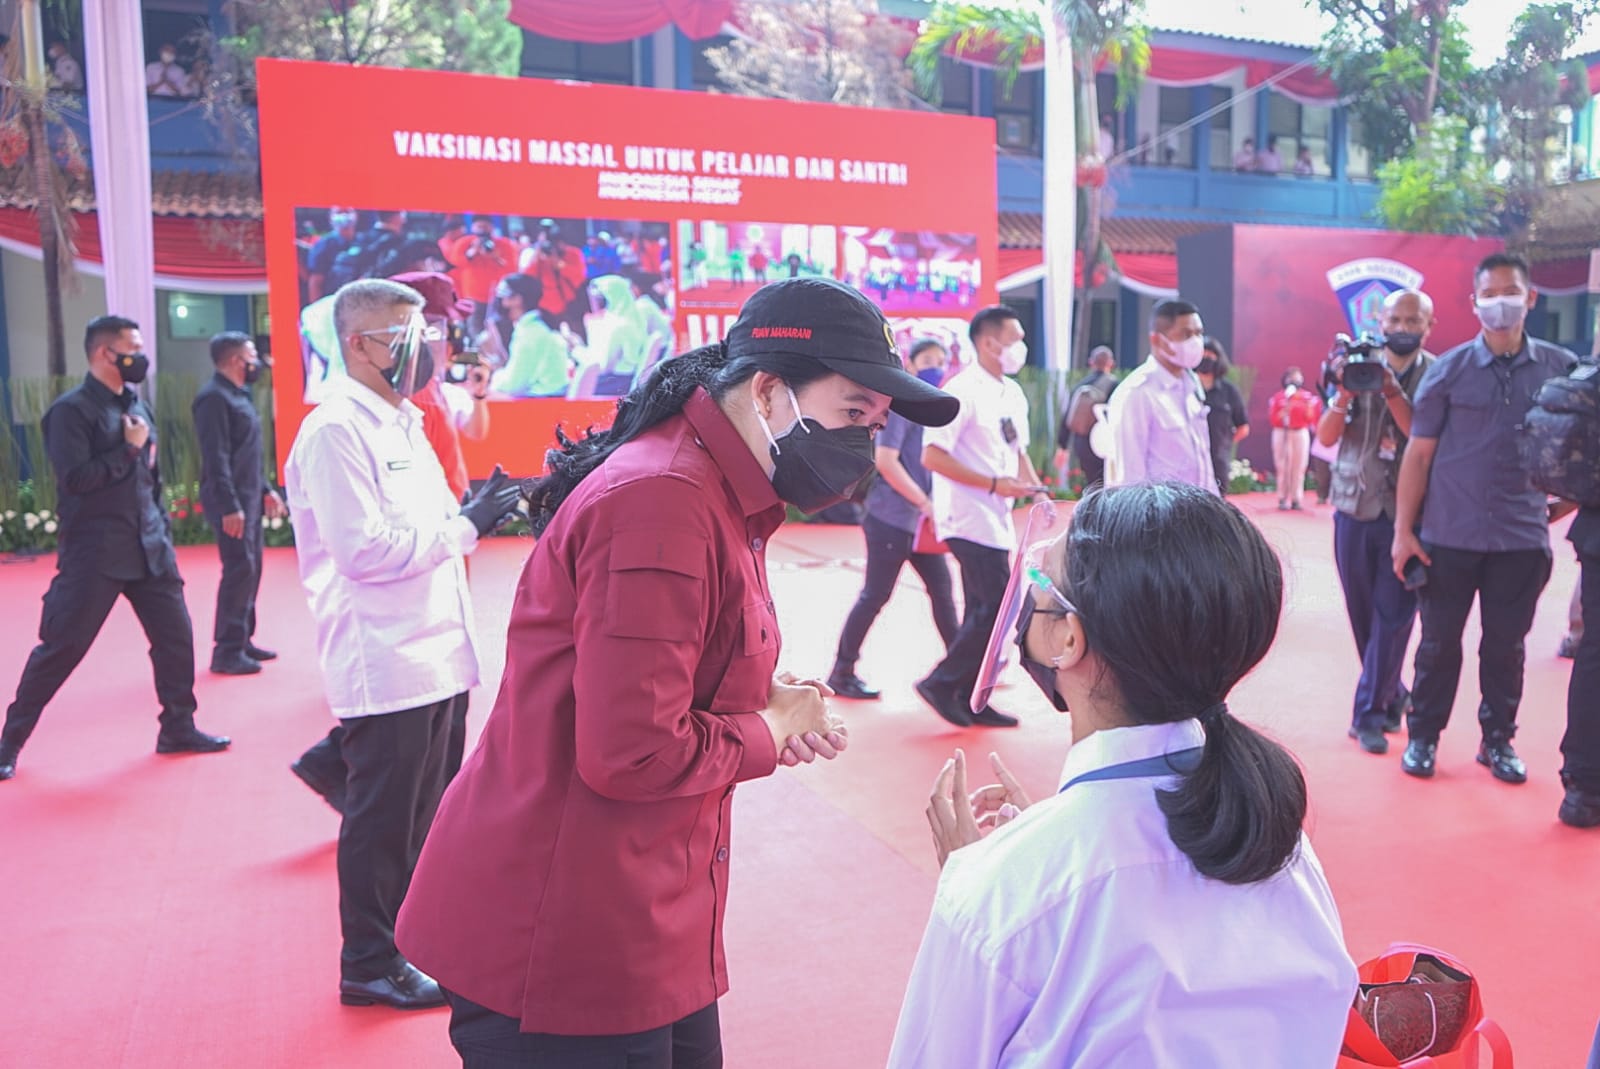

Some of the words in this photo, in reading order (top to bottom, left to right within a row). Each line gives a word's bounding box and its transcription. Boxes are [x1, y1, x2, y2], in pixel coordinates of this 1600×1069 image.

[393, 131, 521, 162] VAKSINASI
[528, 139, 618, 168] MASSAL
[624, 145, 696, 172] UNTUK
[701, 150, 790, 178] PELAJAR
[794, 156, 835, 181] DAN
[839, 159, 908, 186] SANTRI
[770, 327, 812, 340] MAHARANI
